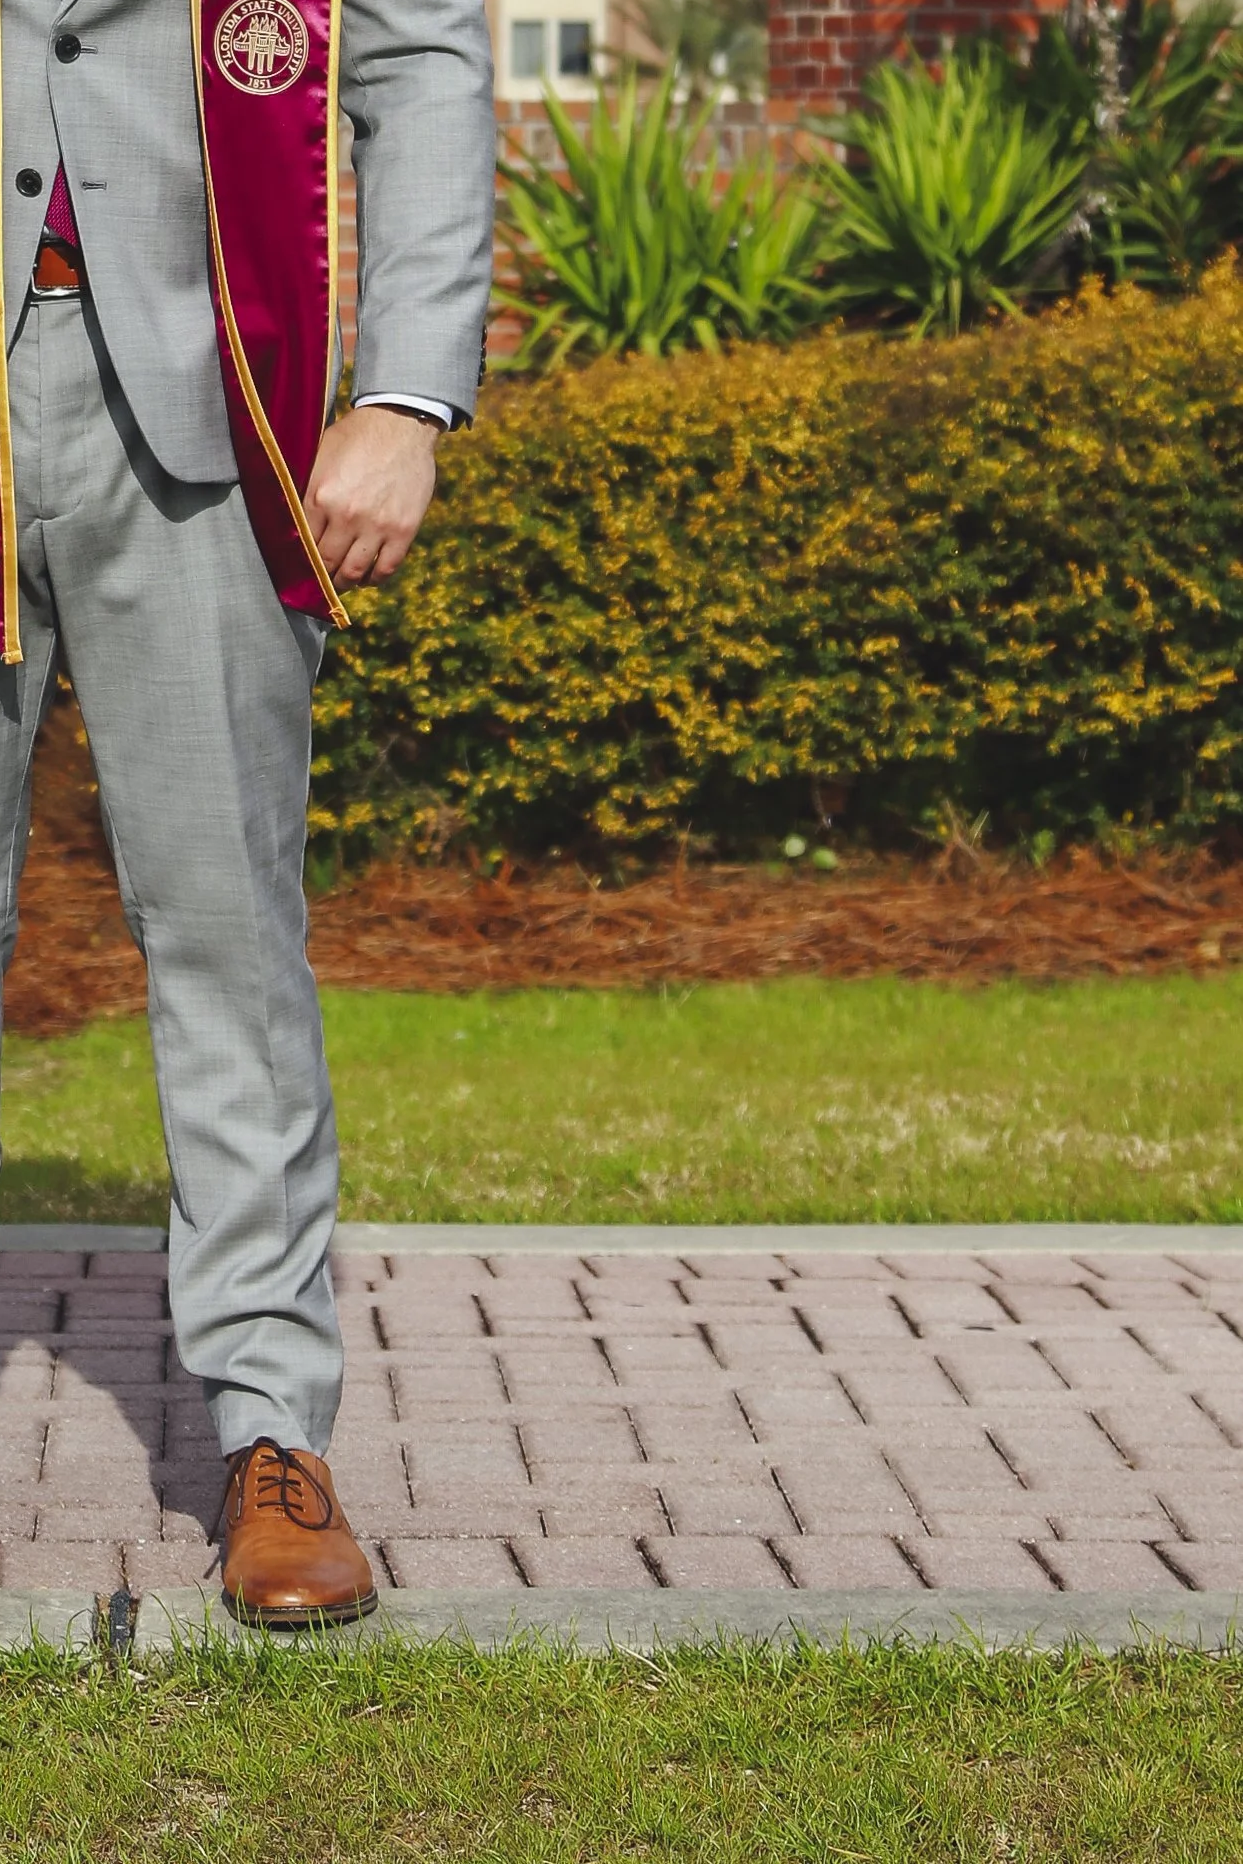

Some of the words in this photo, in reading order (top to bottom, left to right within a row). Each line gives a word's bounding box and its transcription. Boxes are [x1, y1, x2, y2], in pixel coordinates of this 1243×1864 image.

[220, 13, 241, 68] FLORIDA
[240, 0, 276, 14] STATE
[278, 5, 304, 75] UNIVERSITY
[247, 77, 272, 89] 1851
